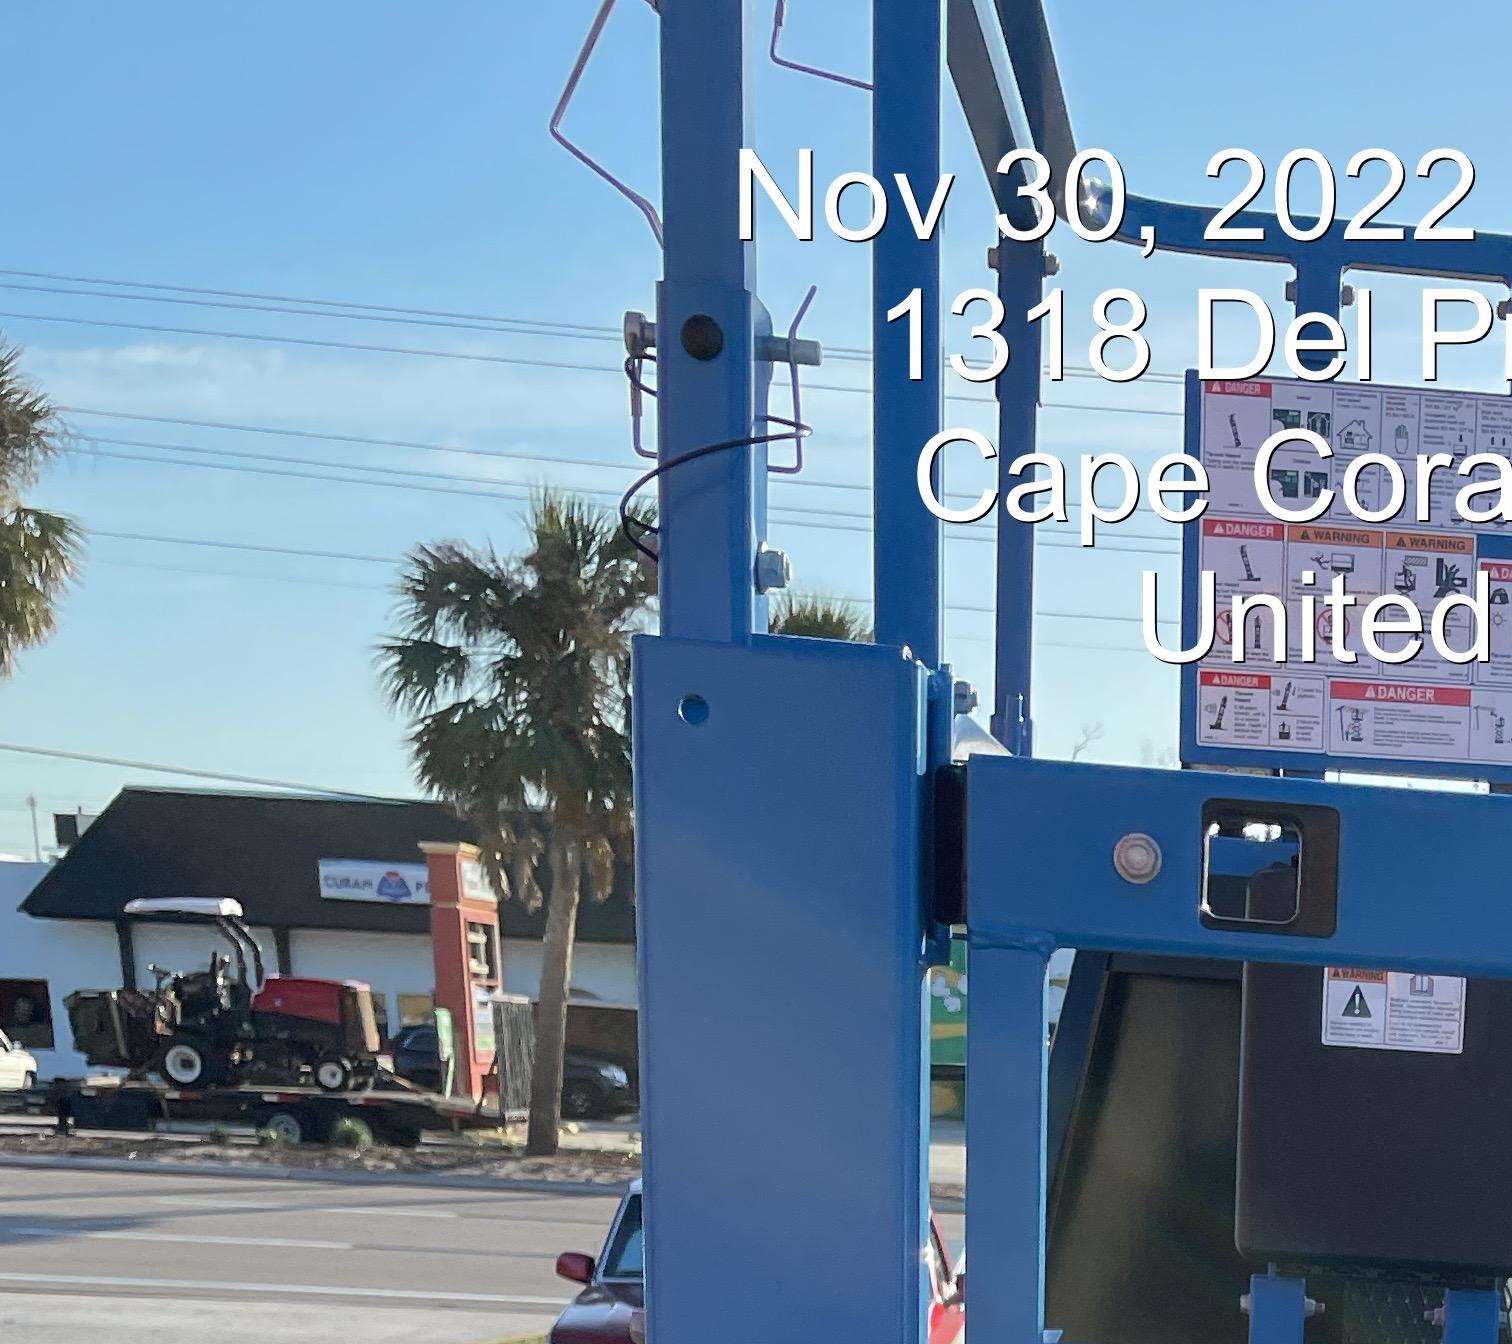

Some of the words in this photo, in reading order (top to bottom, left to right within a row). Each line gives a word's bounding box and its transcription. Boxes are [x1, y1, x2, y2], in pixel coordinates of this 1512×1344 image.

[1225, 382, 1261, 395] DANGER
[1226, 524, 1274, 537] DANGER
[1313, 530, 1370, 544] WARNING
[1409, 537, 1466, 551] WARNING
[1220, 675, 1259, 687] DANGER
[1378, 688, 1435, 702] DANGER
[1341, 967, 1384, 981] WARNING
